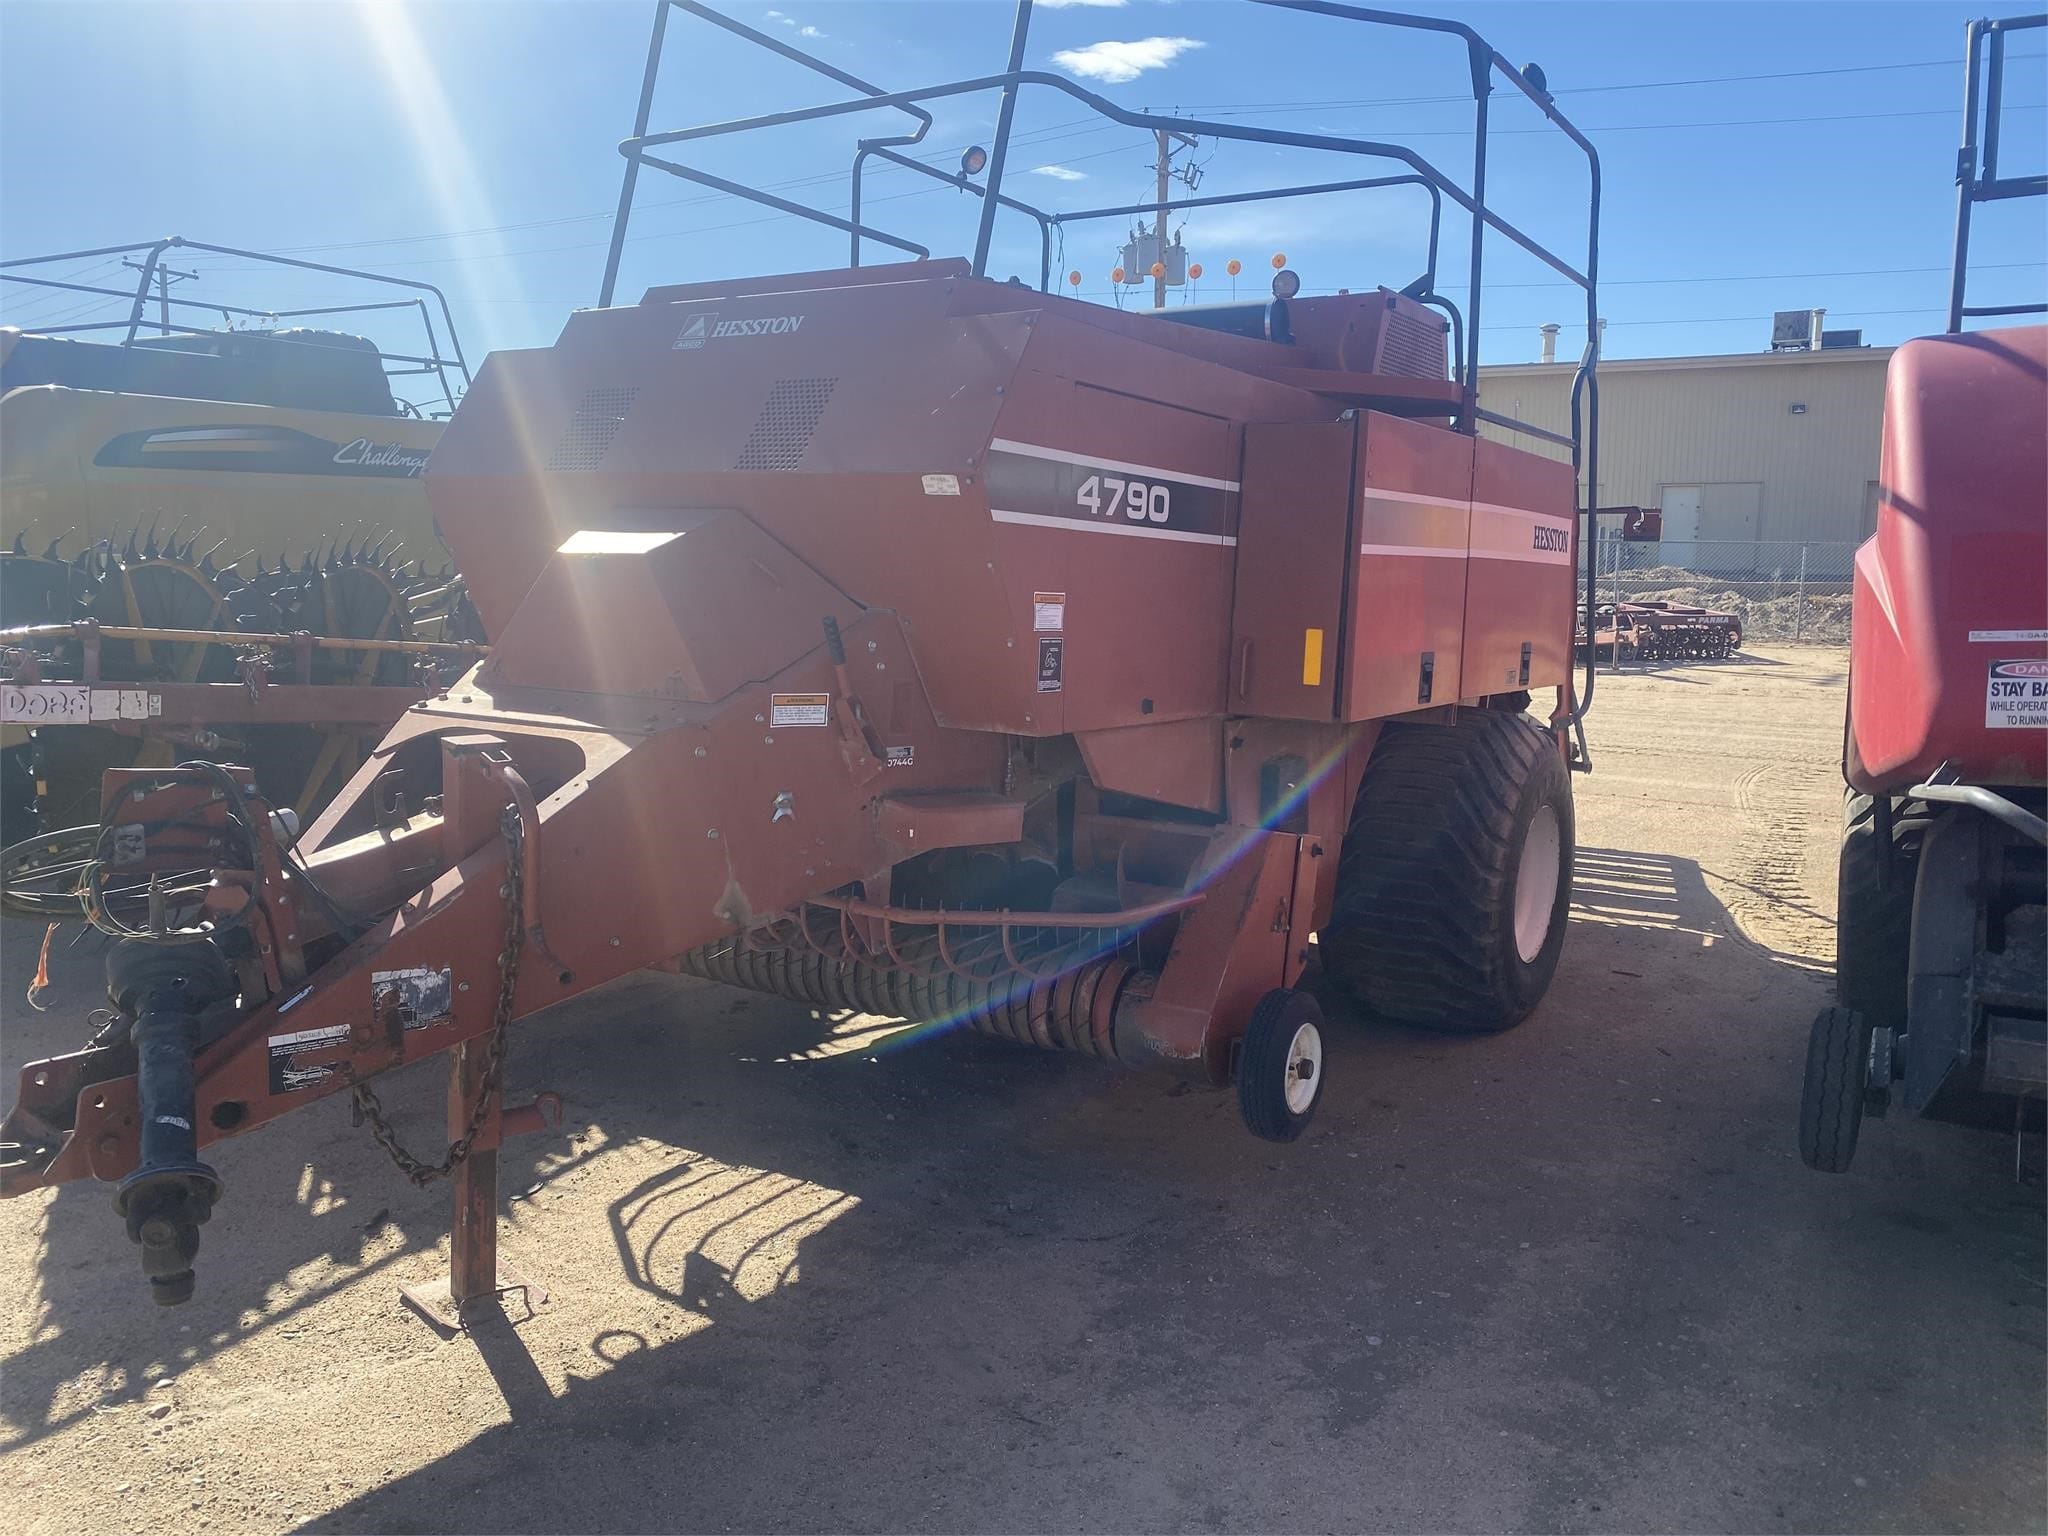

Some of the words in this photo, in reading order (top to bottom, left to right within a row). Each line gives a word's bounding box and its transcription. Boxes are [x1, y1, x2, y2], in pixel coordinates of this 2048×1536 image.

[711, 315, 805, 338] HESSTON
[1076, 475, 1171, 523] 4790
[1532, 524, 1569, 553] HESSTON
[1698, 616, 1729, 624] PARMA
[1991, 682, 2027, 697] STAY
[1990, 701, 2015, 711] WHILE
[2007, 715, 2018, 725] TO
